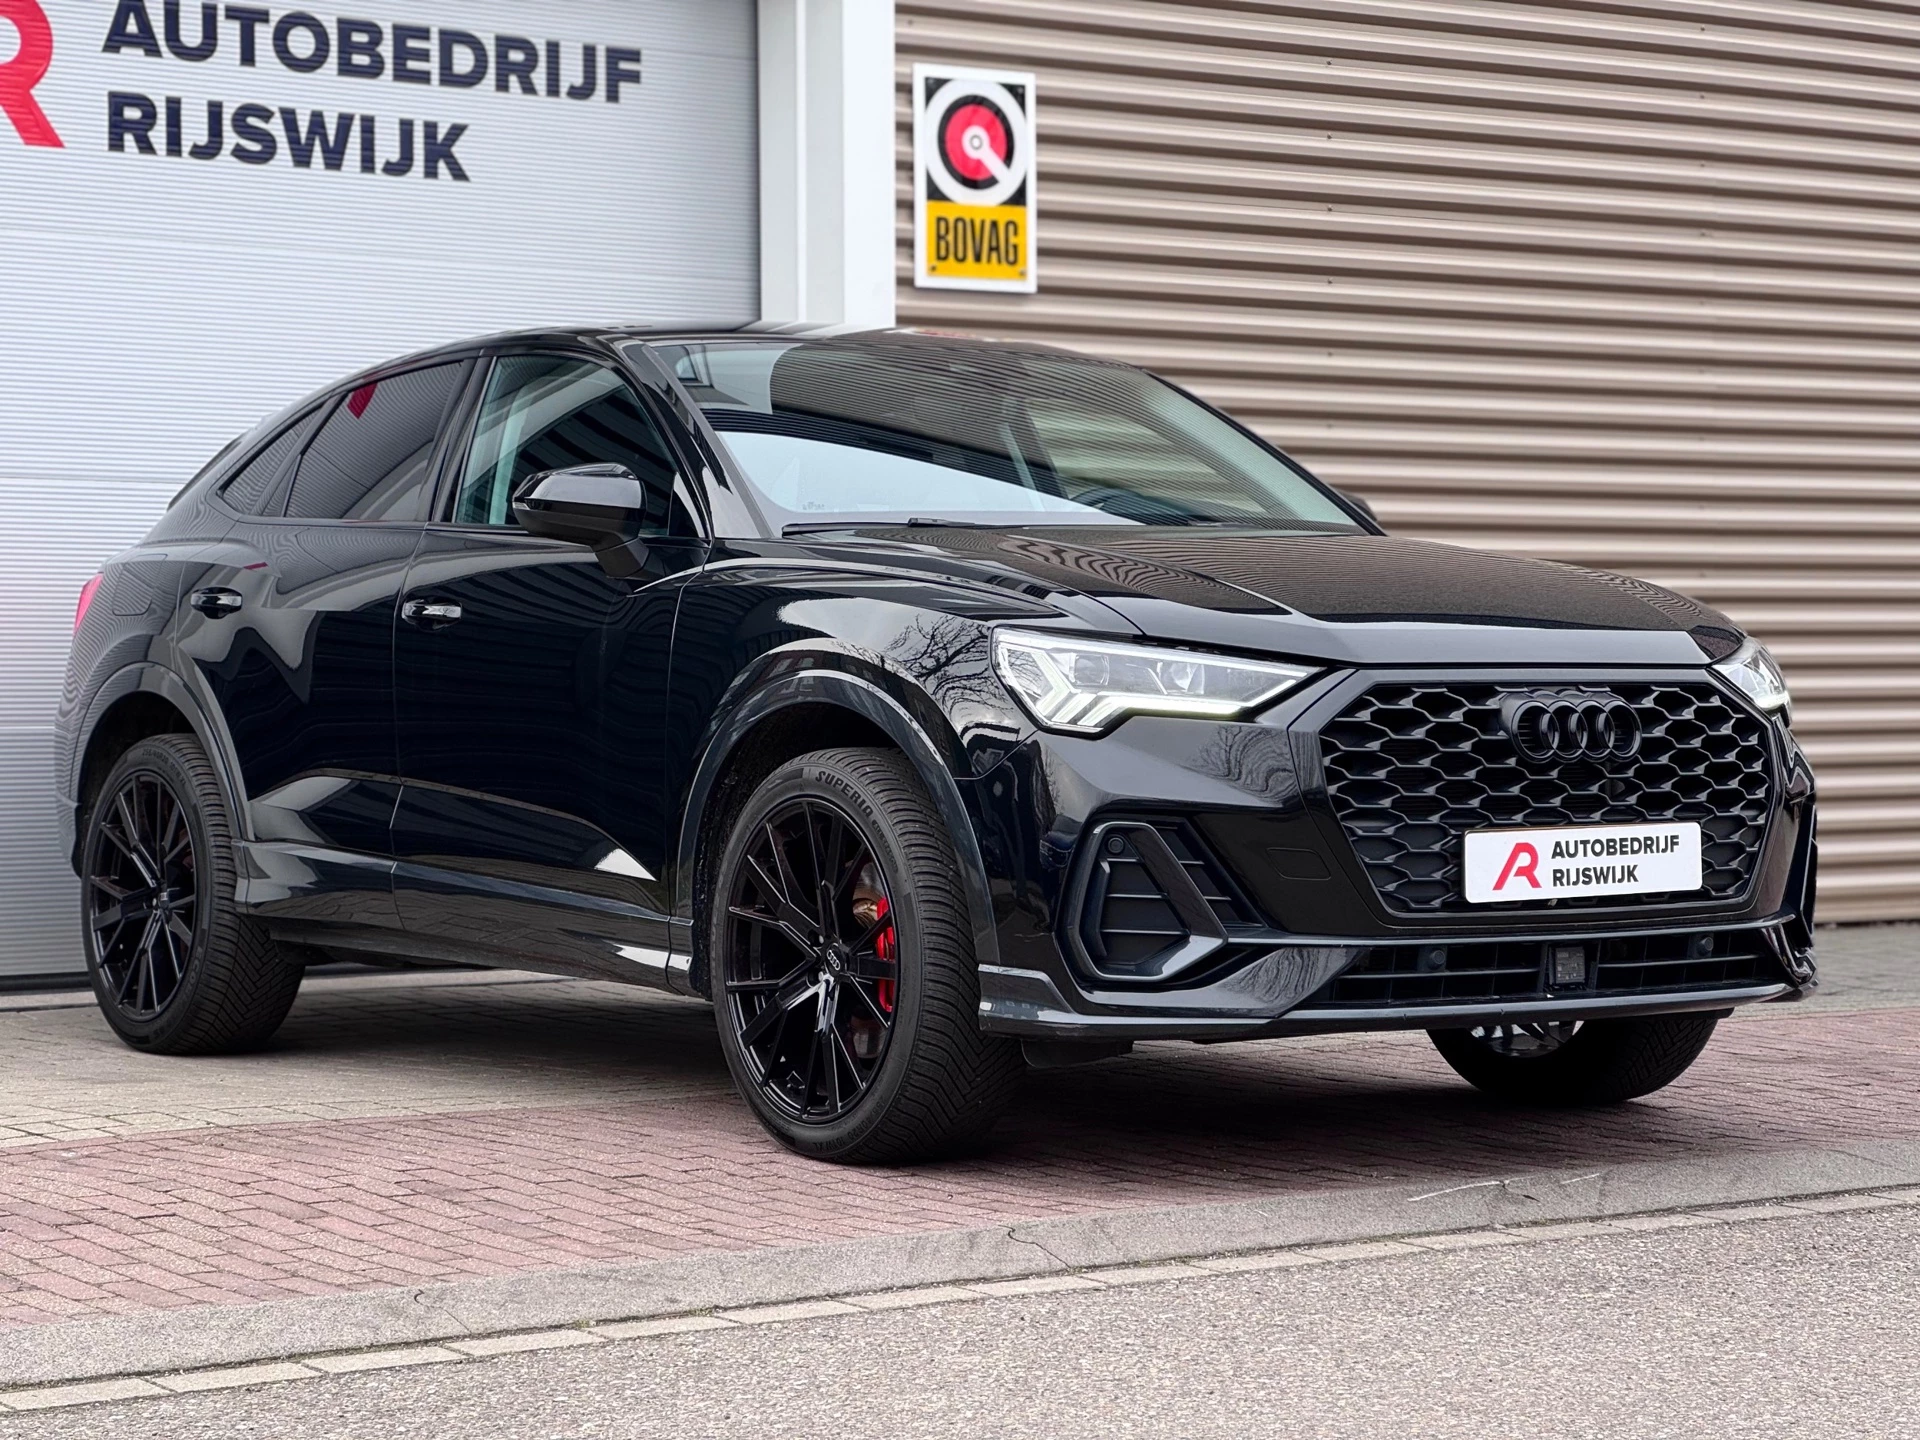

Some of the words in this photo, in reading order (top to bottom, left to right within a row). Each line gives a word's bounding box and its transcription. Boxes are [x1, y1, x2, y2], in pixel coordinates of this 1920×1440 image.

[102, 0, 642, 103] AUTOBEDRIJF
[107, 91, 471, 183] RIJSWIJK
[935, 216, 1019, 266] BOVAG
[814, 770, 874, 819] SUPERIA
[1551, 834, 1680, 859] AUTOBEDRIJF
[1552, 864, 1639, 887] RIJSWIJK
